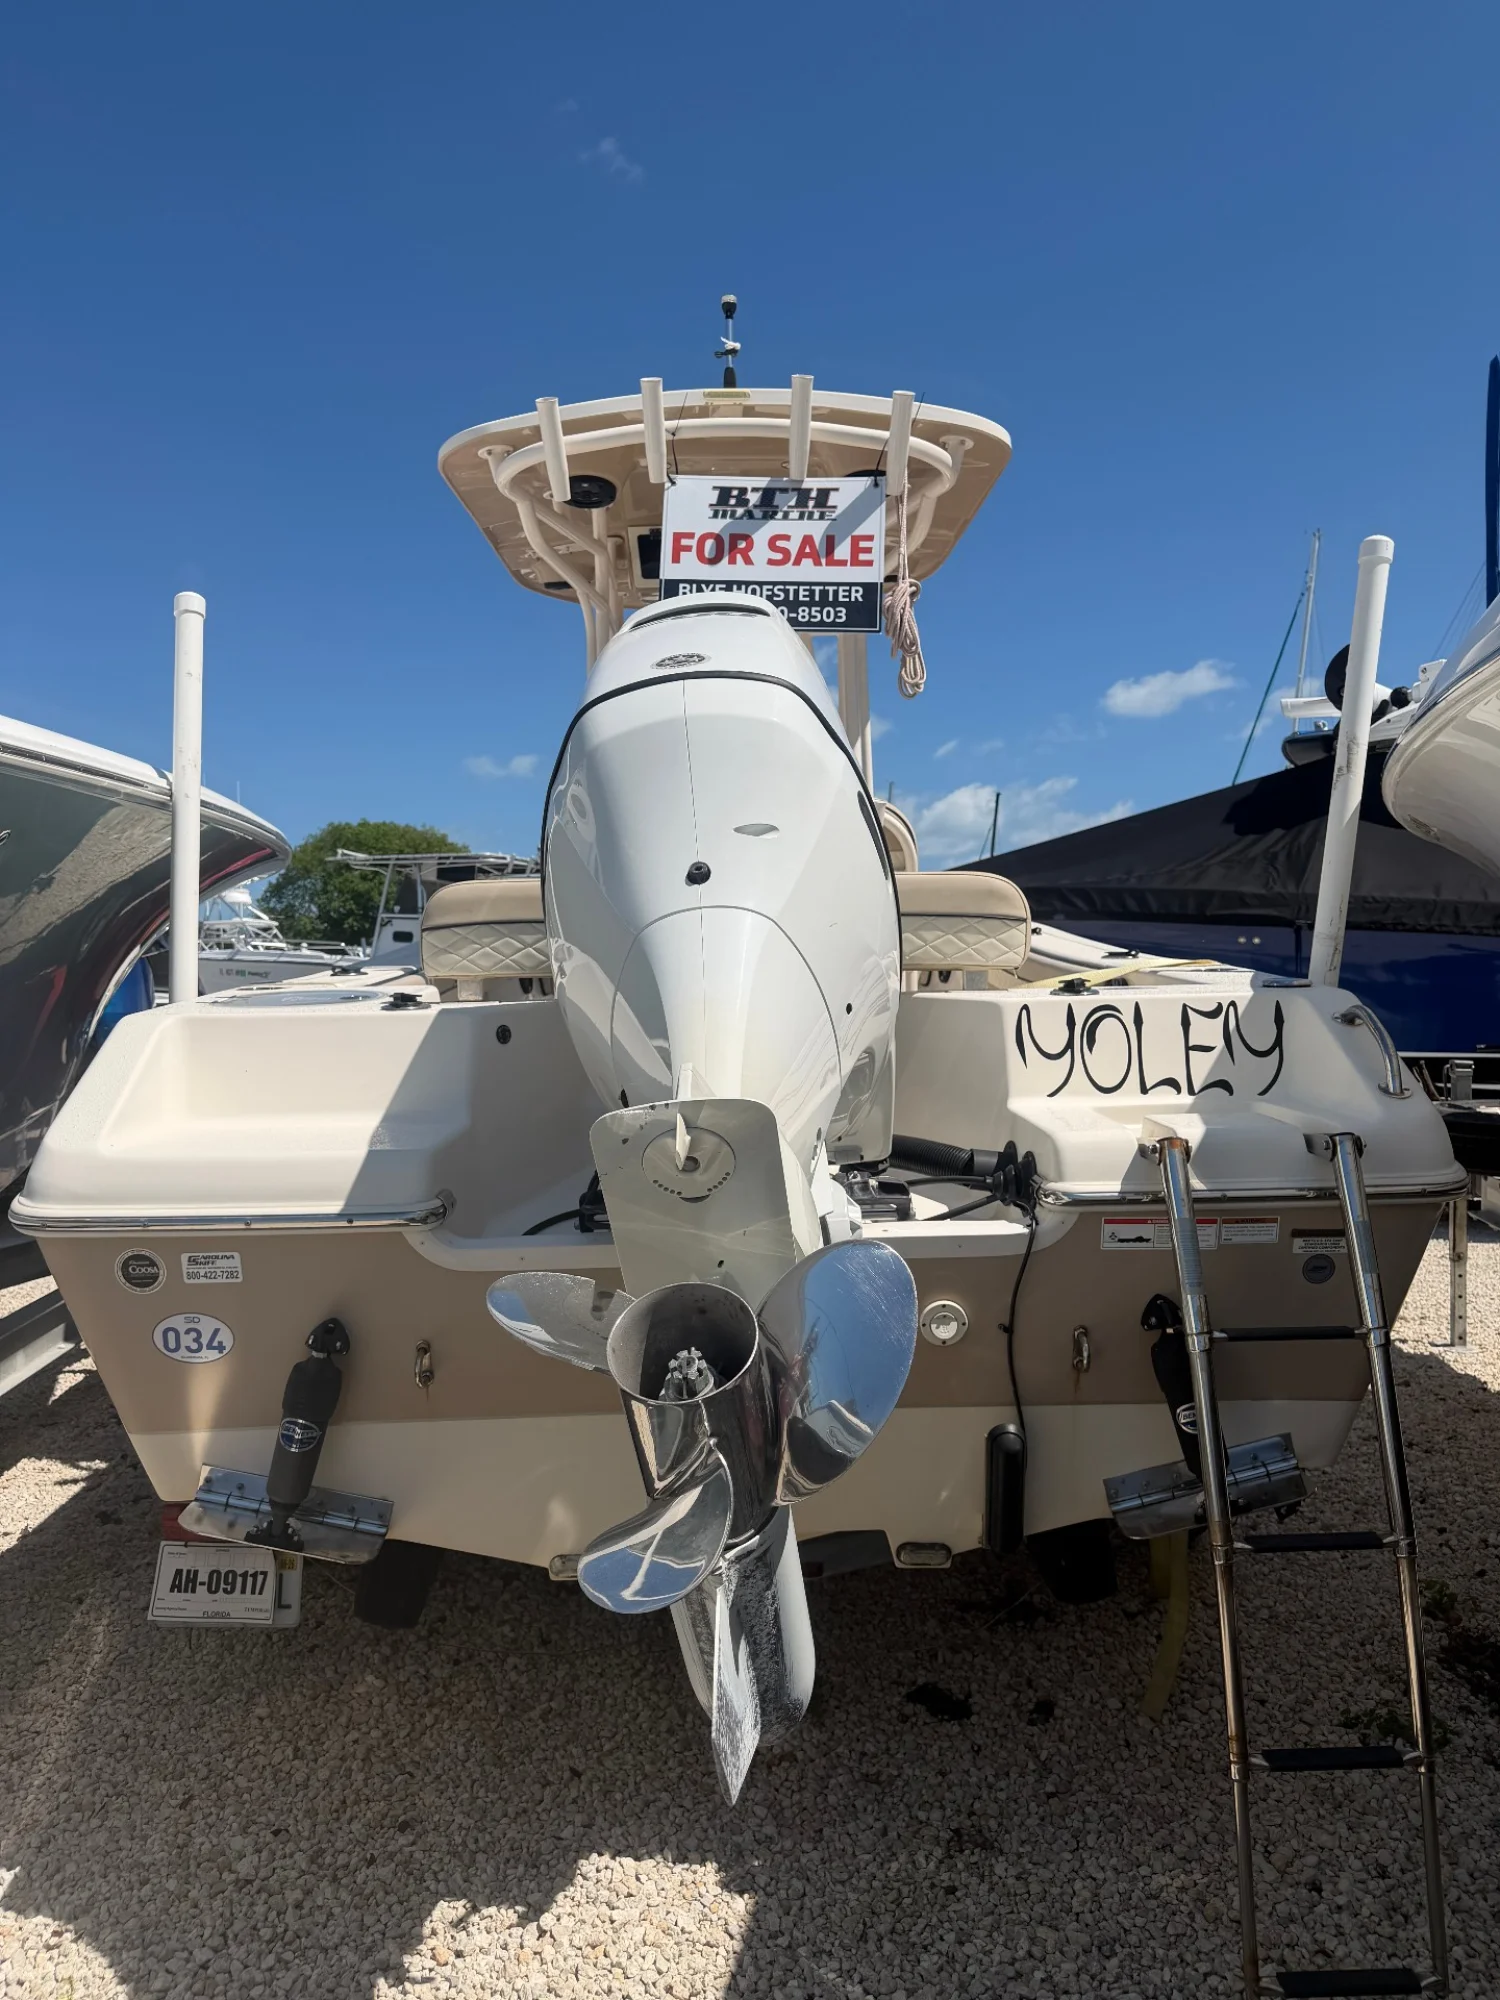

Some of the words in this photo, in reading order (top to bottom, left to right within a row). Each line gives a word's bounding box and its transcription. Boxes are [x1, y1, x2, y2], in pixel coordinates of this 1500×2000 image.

[709, 486, 840, 510] BTH
[708, 508, 837, 521] MARINE
[671, 531, 755, 566] FOR
[766, 533, 875, 568] SALE
[732, 584, 864, 602] HOFSTETTER
[186, 1270, 240, 1280] 800-422-7282
[161, 1326, 227, 1355] 034
[169, 1568, 269, 1596] AH-09117
[202, 1610, 231, 1618] FLORIDA
